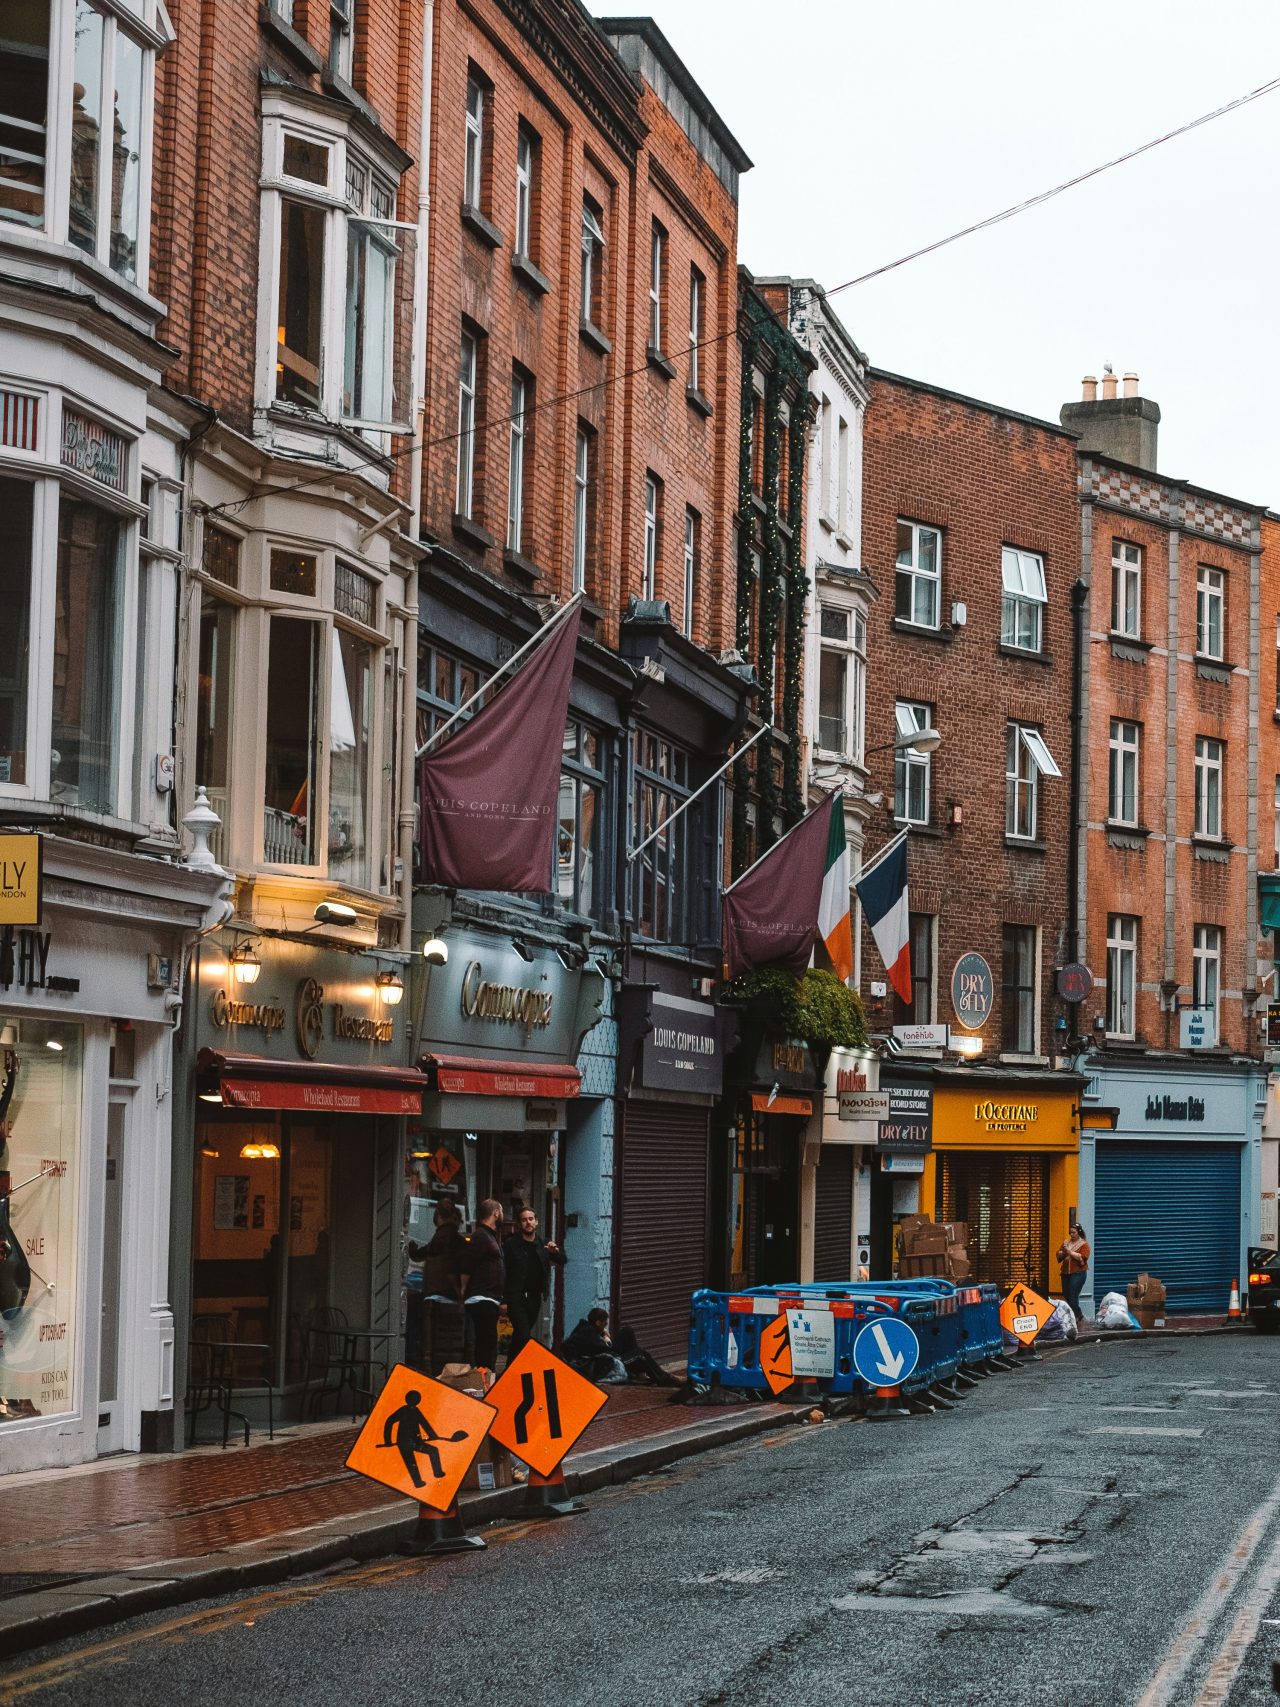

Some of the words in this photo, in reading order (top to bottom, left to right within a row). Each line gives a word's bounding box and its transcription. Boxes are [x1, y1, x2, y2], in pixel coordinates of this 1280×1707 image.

[470, 801, 551, 815] COPELAND
[0, 861, 26, 889] LY
[960, 973, 986, 993] DRY
[654, 1027, 676, 1049] LOUIS
[677, 1032, 715, 1055] COPELAND
[880, 1124, 901, 1140] DRY
[909, 1125, 928, 1141] FLY
[26, 1237, 45, 1257] SALE
[41, 1371, 55, 1385] KIDS
[55, 1369, 68, 1382] CAN
